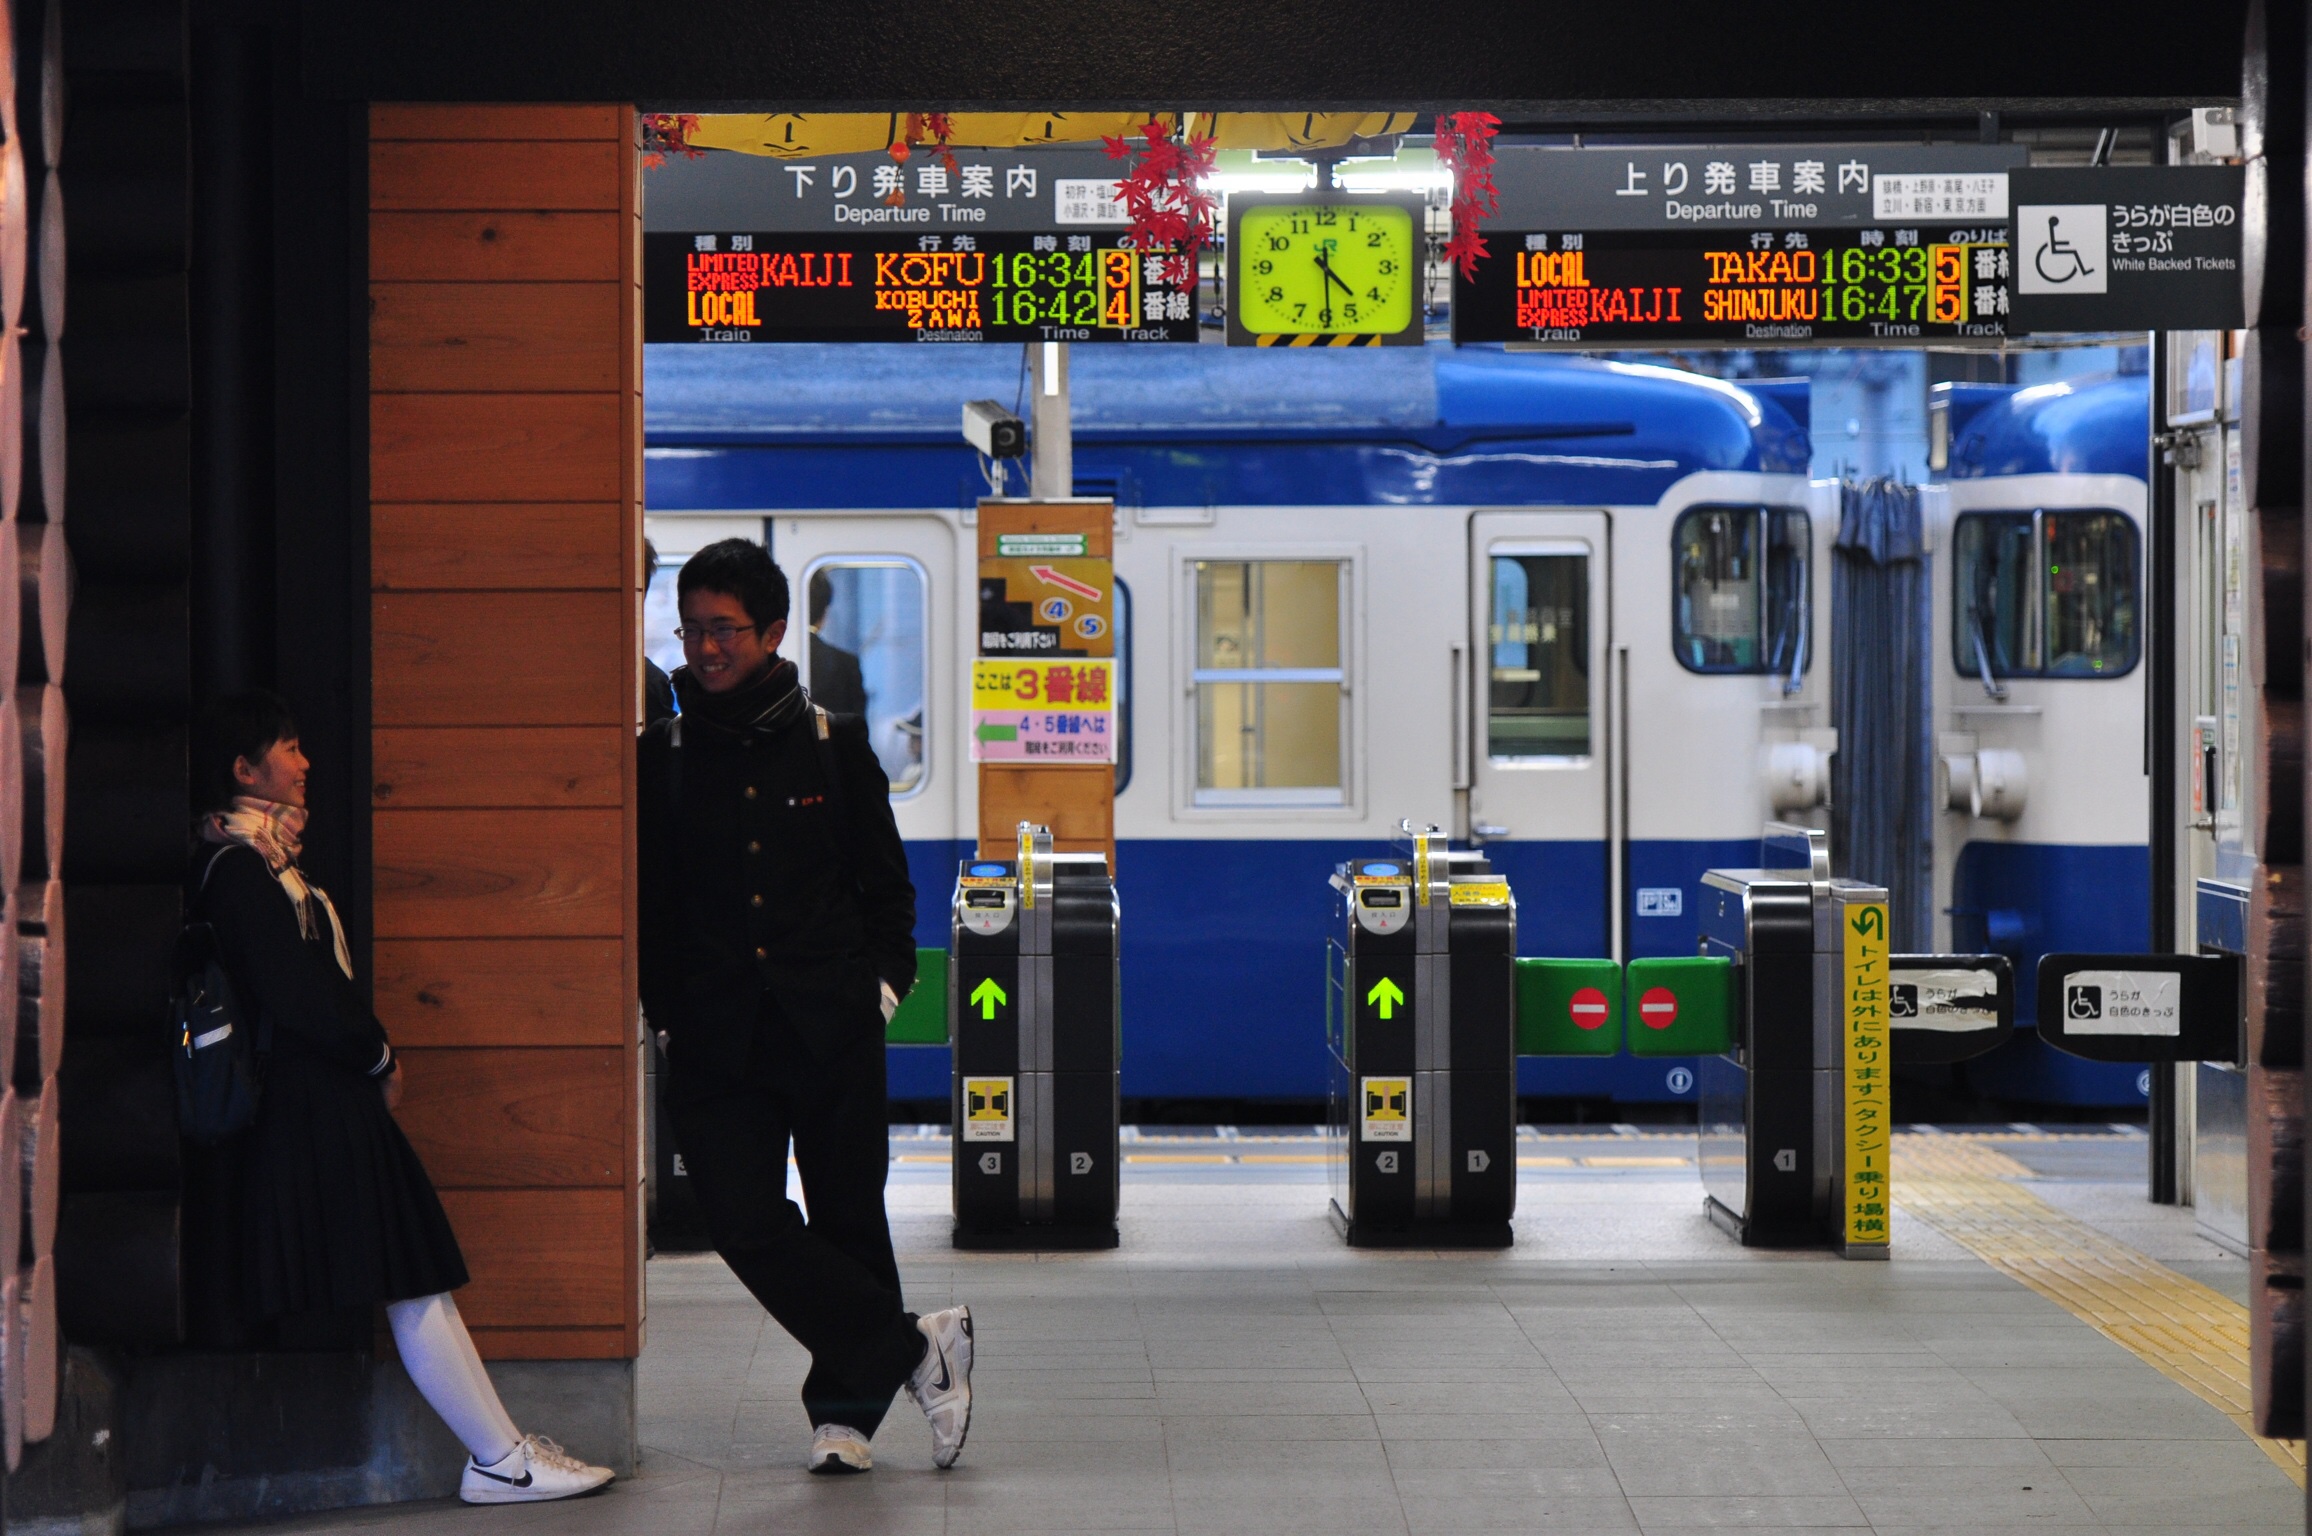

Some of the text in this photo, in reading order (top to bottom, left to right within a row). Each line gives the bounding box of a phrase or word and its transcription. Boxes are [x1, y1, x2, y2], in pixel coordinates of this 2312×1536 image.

[783, 164, 1037, 199] 下り発車案内
[1615, 159, 1869, 196] 上り発車案内
[834, 204, 986, 225] Departure Time
[1315, 211, 1337, 226] 12
[1666, 200, 1817, 222] Departure Time
[2112, 204, 2235, 228] うらが白色の
[1291, 220, 1310, 235] 11
[1349, 217, 1357, 232] 1
[695, 235, 1091, 251] 種別 行先 時刻
[1269, 236, 1289, 251] 10
[1367, 233, 1381, 247] 2
[1525, 233, 1583, 250] 種別
[1750, 232, 1808, 249] 行先
[1861, 230, 1918, 247] 時刻
[2112, 231, 2173, 253] きっぷ
[688, 253, 759, 272] LIMITED
[760, 253, 853, 287] KAIJI
[992, 252, 1096, 287] 16:34
[1106, 252, 1131, 288] 3
[1259, 260, 1273, 275] 9
[1379, 260, 1393, 275] 3
[1517, 247, 1926, 287] LOCAL TAKAO 16:33
[1936, 246, 1960, 283] 5
[2112, 256, 2236, 271] White Backed Tickets
[688, 272, 759, 291] EXPRESS
[1269, 287, 1283, 301] 8
[1367, 287, 1381, 301] 4
[1517, 289, 1588, 308] LIMITED
[1936, 285, 1960, 321] 5
[687, 290, 1097, 326] LOCAL KOBUCHI 16:42
[1106, 290, 1131, 326] 4
[1143, 291, 1190, 320] 番線
[1294, 304, 1307, 318] 7
[1344, 304, 1357, 318] 5
[1590, 285, 1926, 322] KAIJI SHINJUKU 16:47
[908, 309, 981, 328] ZAWA
[1319, 309, 1332, 324] 6
[1517, 308, 1588, 328] EXPRESS
[700, 325, 1170, 342] Train Destination Time Track
[1530, 322, 2005, 341] Train Destination Time Track
[2110, 990, 2140, 1001] うらが
[2110, 1006, 2174, 1017] 白色のきっぷ
[988, 1157, 997, 1170] 3
[1076, 1157, 1085, 1170] 2
[1384, 1156, 1393, 1169] 2
[1474, 1155, 1480, 1167] 1
[1783, 1154, 1790, 1166] 1
